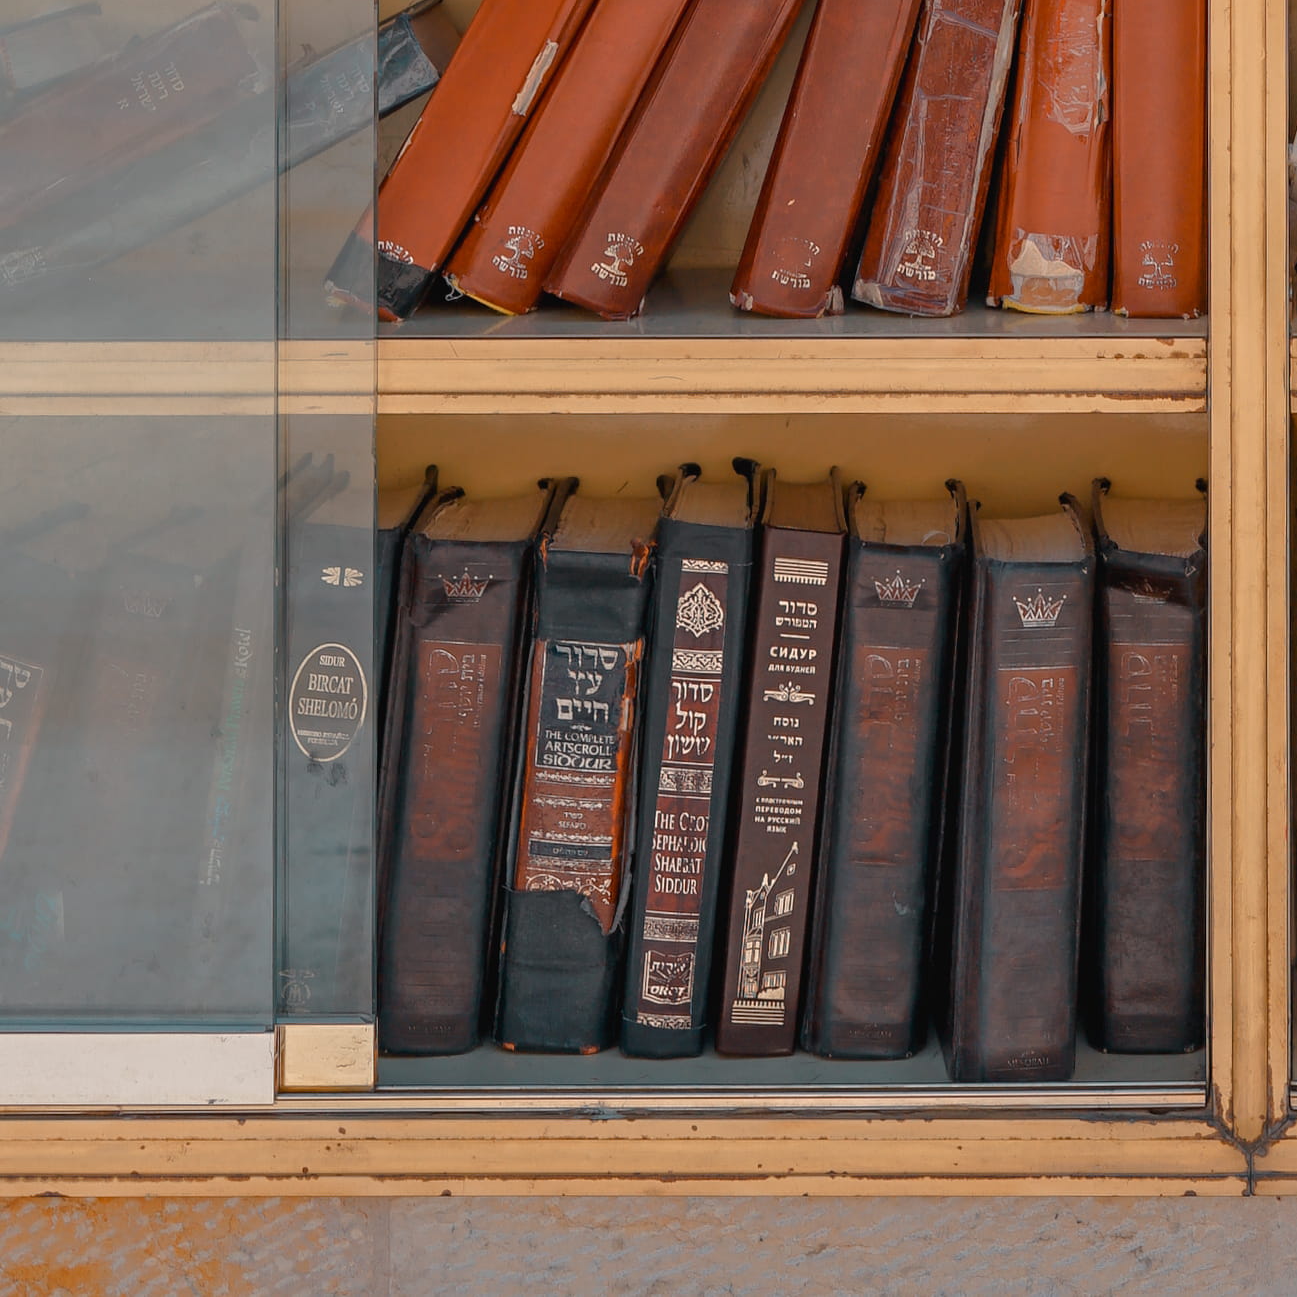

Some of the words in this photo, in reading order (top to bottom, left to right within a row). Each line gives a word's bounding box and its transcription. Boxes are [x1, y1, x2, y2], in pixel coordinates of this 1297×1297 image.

[779, 600, 817, 616] סדור
[319, 655, 346, 668] SIDUR
[555, 644, 618, 670] סדור
[770, 646, 817, 660] СИДУР
[768, 664, 784, 672] ДЛЯ
[785, 664, 816, 674] БУДНЕЙ
[308, 674, 353, 693] BIRCAT
[567, 669, 603, 695] עץ
[670, 681, 712, 704] סדור
[297, 697, 359, 721] SHELOMÓ
[556, 698, 609, 723] חיים
[676, 702, 707, 734] קול
[773, 717, 799, 728] נוסח
[545, 730, 562, 740] THE
[564, 733, 615, 744] COMPLETE
[545, 741, 612, 756] ARTSCROLL
[755, 806, 802, 815] ПЕРЕВОДОМ
[654, 810, 678, 831] THE
[767, 817, 801, 825] РУССКИЙ
[654, 874, 698, 895] SIDDUR
